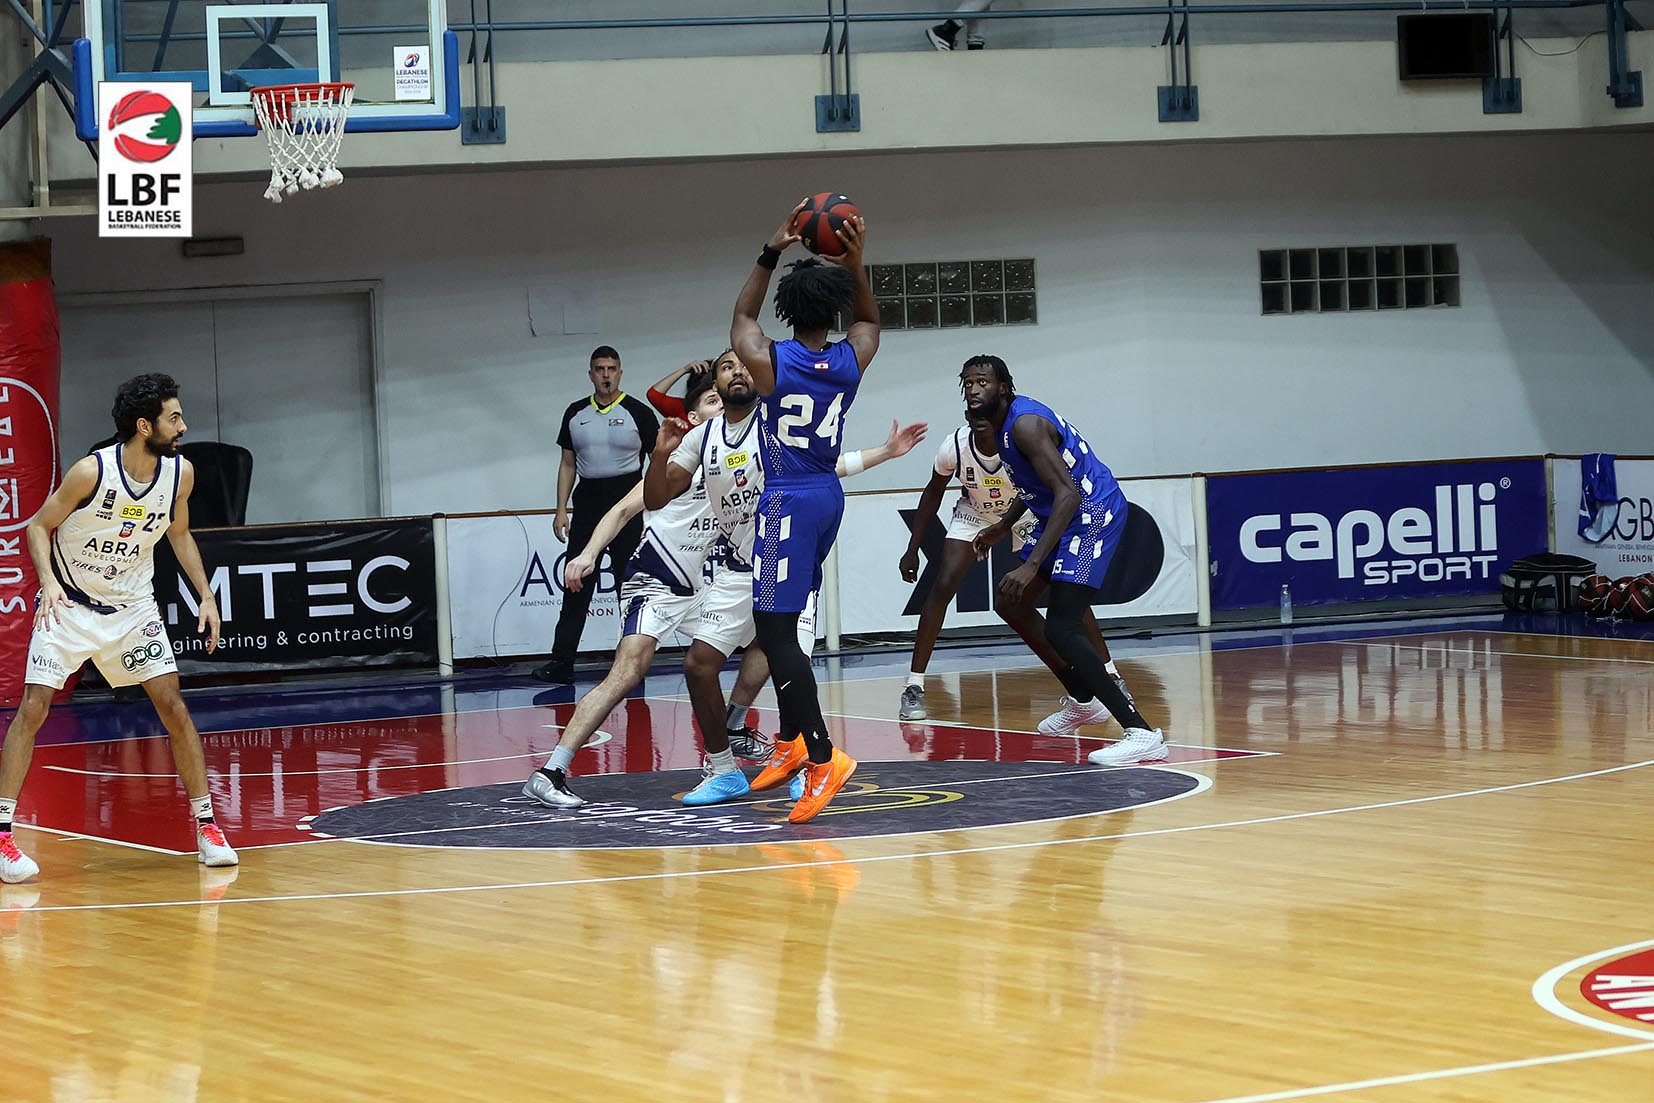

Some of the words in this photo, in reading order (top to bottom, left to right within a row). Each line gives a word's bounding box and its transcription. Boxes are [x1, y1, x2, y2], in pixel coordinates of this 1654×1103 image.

[777, 392, 845, 449] 24
[720, 486, 761, 509] ABRA
[689, 517, 719, 531] ABR
[1239, 483, 1497, 579] capelli
[84, 537, 140, 557] ABRA
[1619, 554, 1653, 563] LEBANON
[1364, 555, 1498, 586] SPORT
[587, 608, 614, 617] NON
[276, 631, 289, 646] &
[298, 624, 413, 645] contracting
